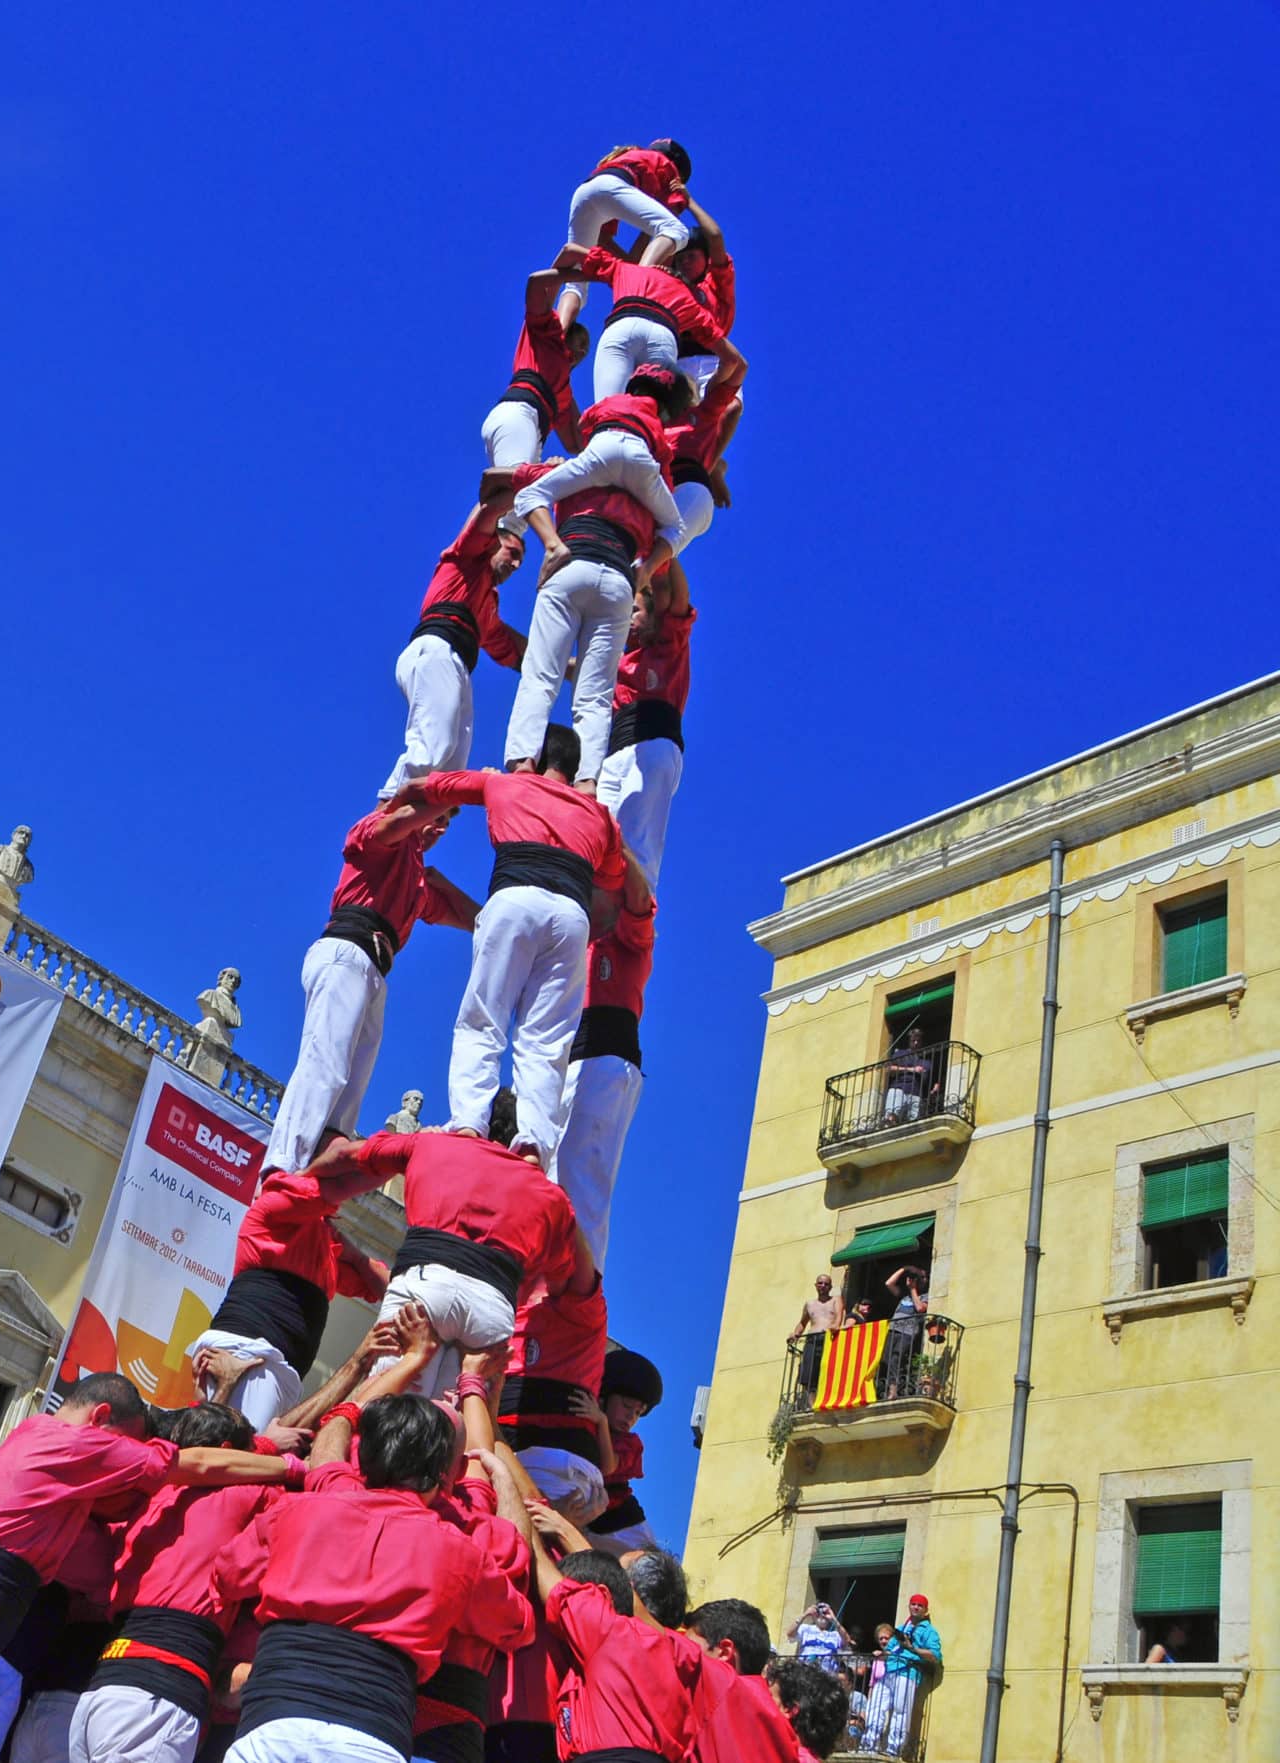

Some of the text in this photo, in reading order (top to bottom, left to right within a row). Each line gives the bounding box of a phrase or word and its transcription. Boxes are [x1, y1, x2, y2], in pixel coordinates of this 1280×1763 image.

[162, 1129, 243, 1187] The Chemical Company
[194, 1122, 252, 1168] BASF
[150, 1167, 178, 1192] AMB
[179, 1184, 195, 1204] LA
[196, 1194, 232, 1226] FESTA
[121, 1219, 160, 1252] SETEMBRE
[159, 1243, 178, 1264] 2012
[183, 1256, 226, 1289] TARRAGONA
